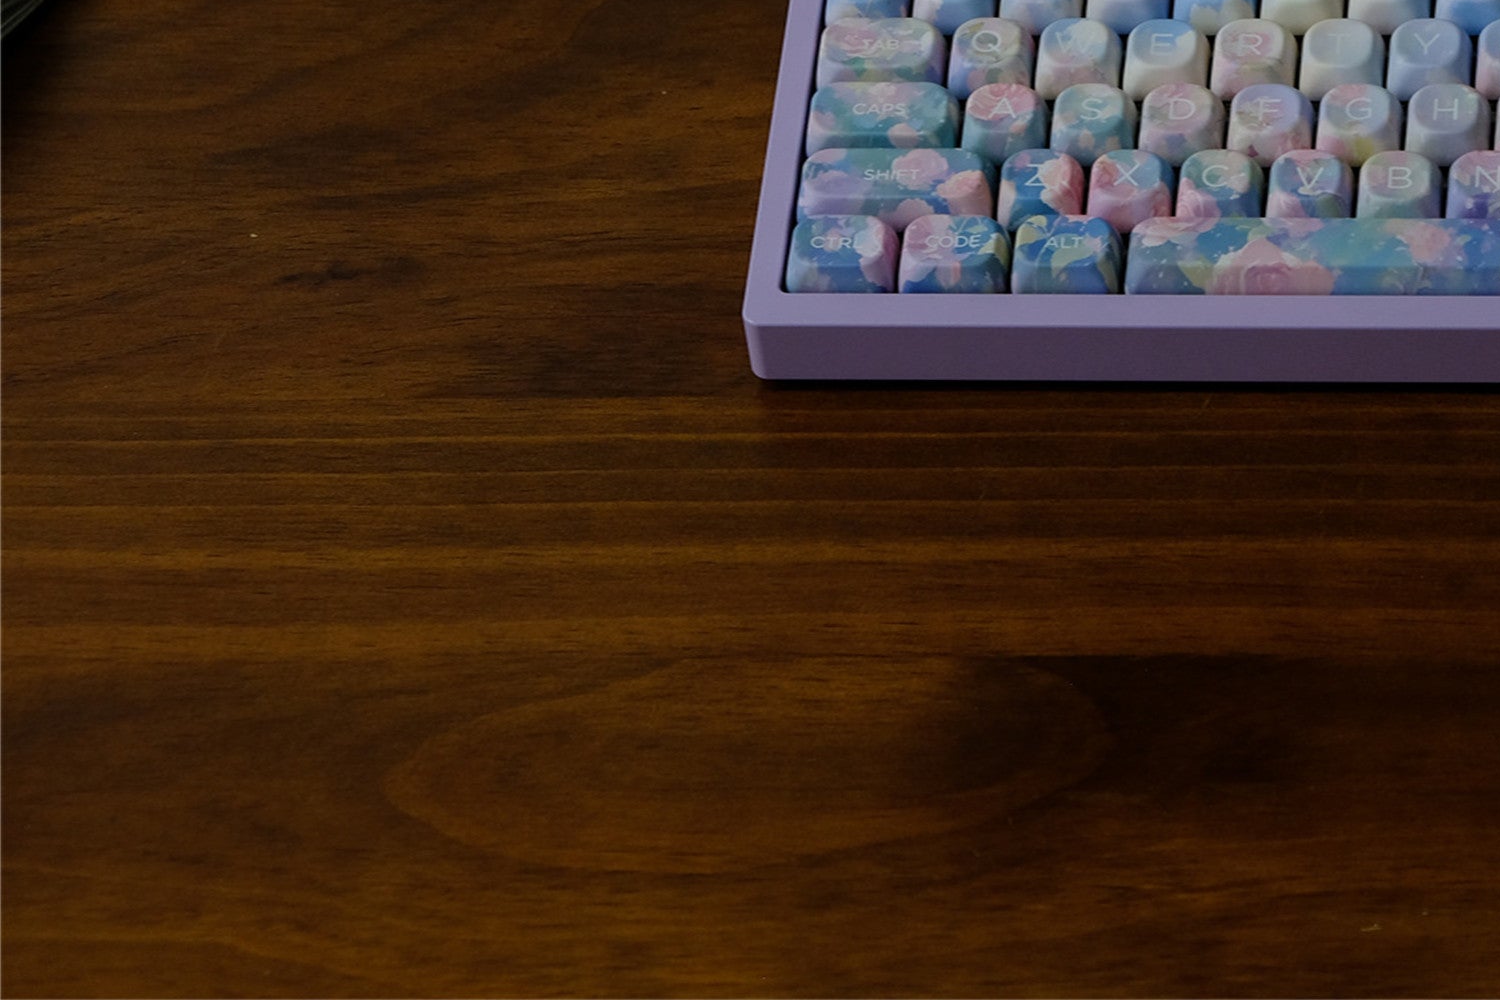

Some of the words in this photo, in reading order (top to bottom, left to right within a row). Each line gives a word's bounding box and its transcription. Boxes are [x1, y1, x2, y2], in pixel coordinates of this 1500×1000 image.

[861, 38, 901, 51] TAB
[972, 30, 1000, 53] Q
[1150, 32, 1174, 56] E
[1241, 33, 1262, 56] R
[1328, 32, 1352, 55] T
[1414, 32, 1440, 55] Y
[852, 103, 907, 116] CAPS
[988, 98, 1016, 119] A
[1080, 98, 1103, 121] S
[1168, 98, 1196, 121] D
[1258, 98, 1282, 122] F
[1345, 98, 1373, 121] G
[1432, 98, 1459, 121] H
[863, 169, 920, 182] SHIFT
[1024, 163, 1051, 187] Z
[1113, 163, 1139, 187] X
[1202, 164, 1229, 188] C
[1296, 166, 1324, 189] V
[1387, 166, 1413, 190] B
[1475, 166, 1500, 189] N
[811, 236, 859, 249] CTRL
[925, 235, 982, 249] CODE
[1044, 236, 1083, 249] ALT
